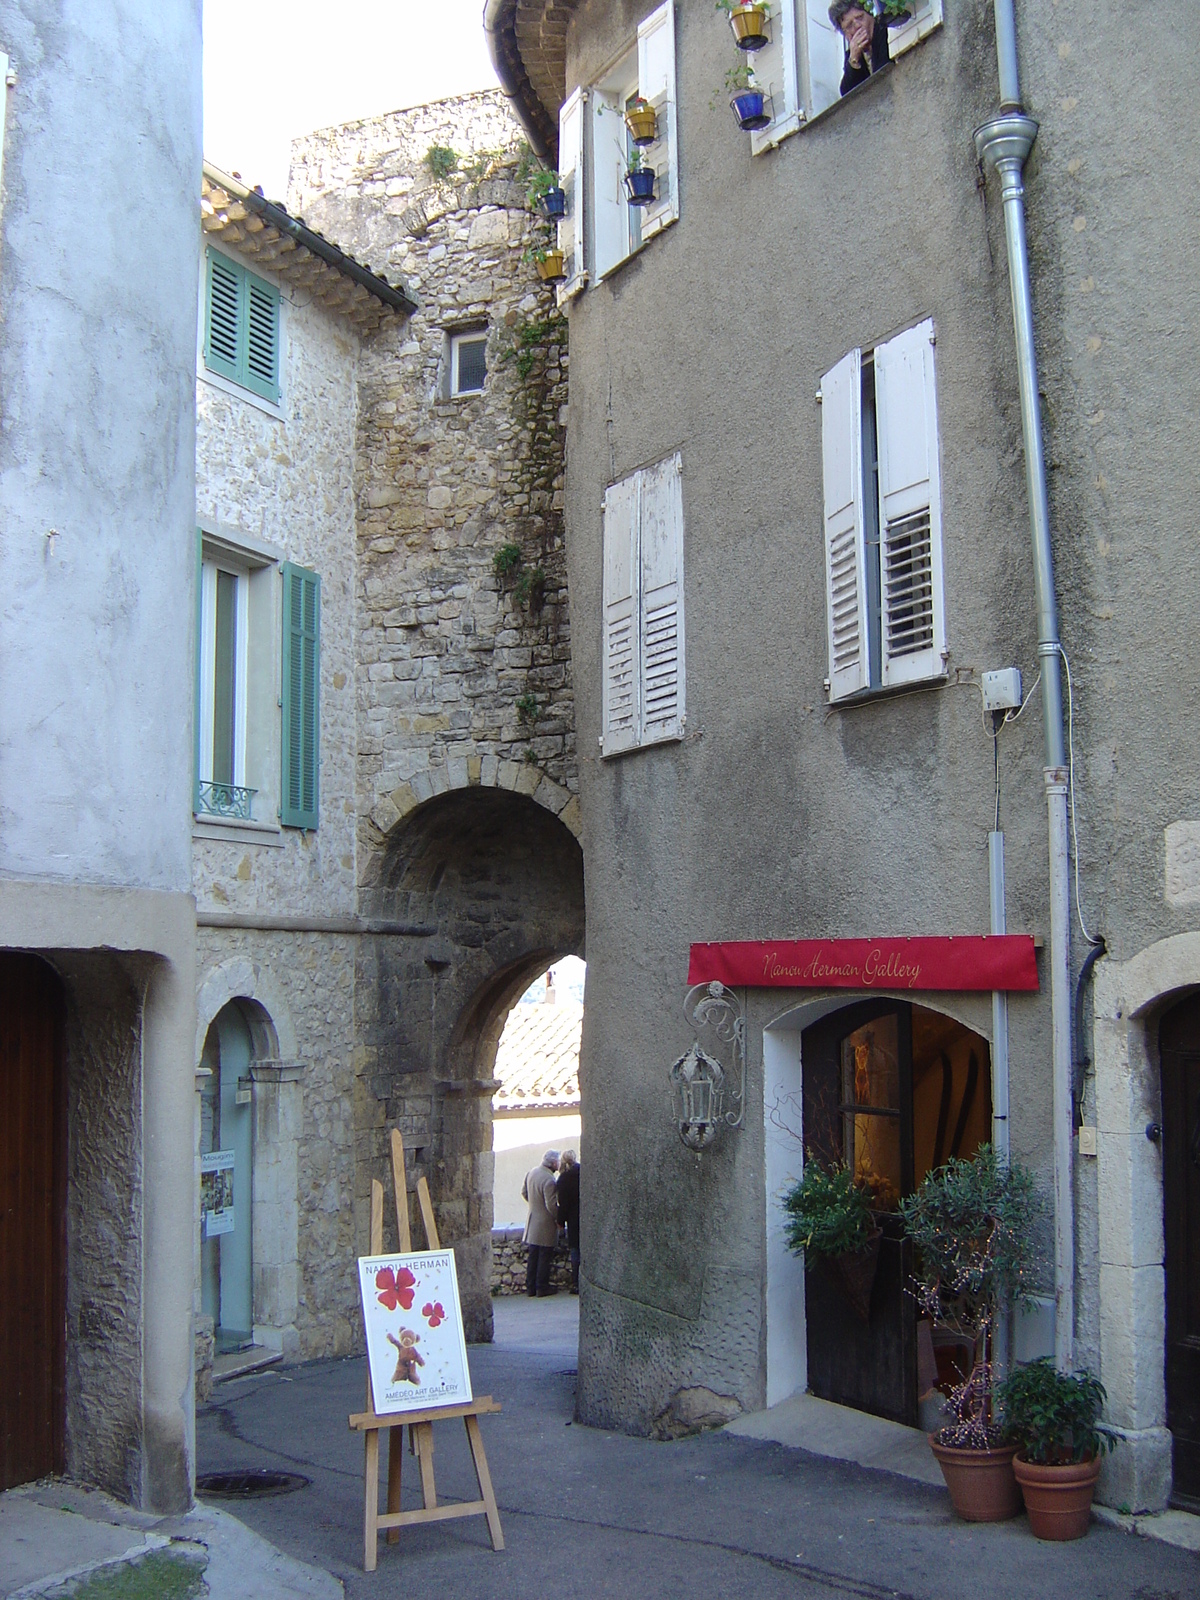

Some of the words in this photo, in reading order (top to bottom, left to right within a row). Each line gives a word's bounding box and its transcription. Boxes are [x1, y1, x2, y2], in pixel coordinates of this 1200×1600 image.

[763, 952, 801, 978] Nanou
[803, 950, 860, 978] Herman
[861, 949, 921, 987] Gallery
[203, 1153, 233, 1161] Mougins
[407, 1260, 448, 1270] HERMAN
[414, 1387, 428, 1396] ART
[429, 1385, 458, 1393] GALLERY
